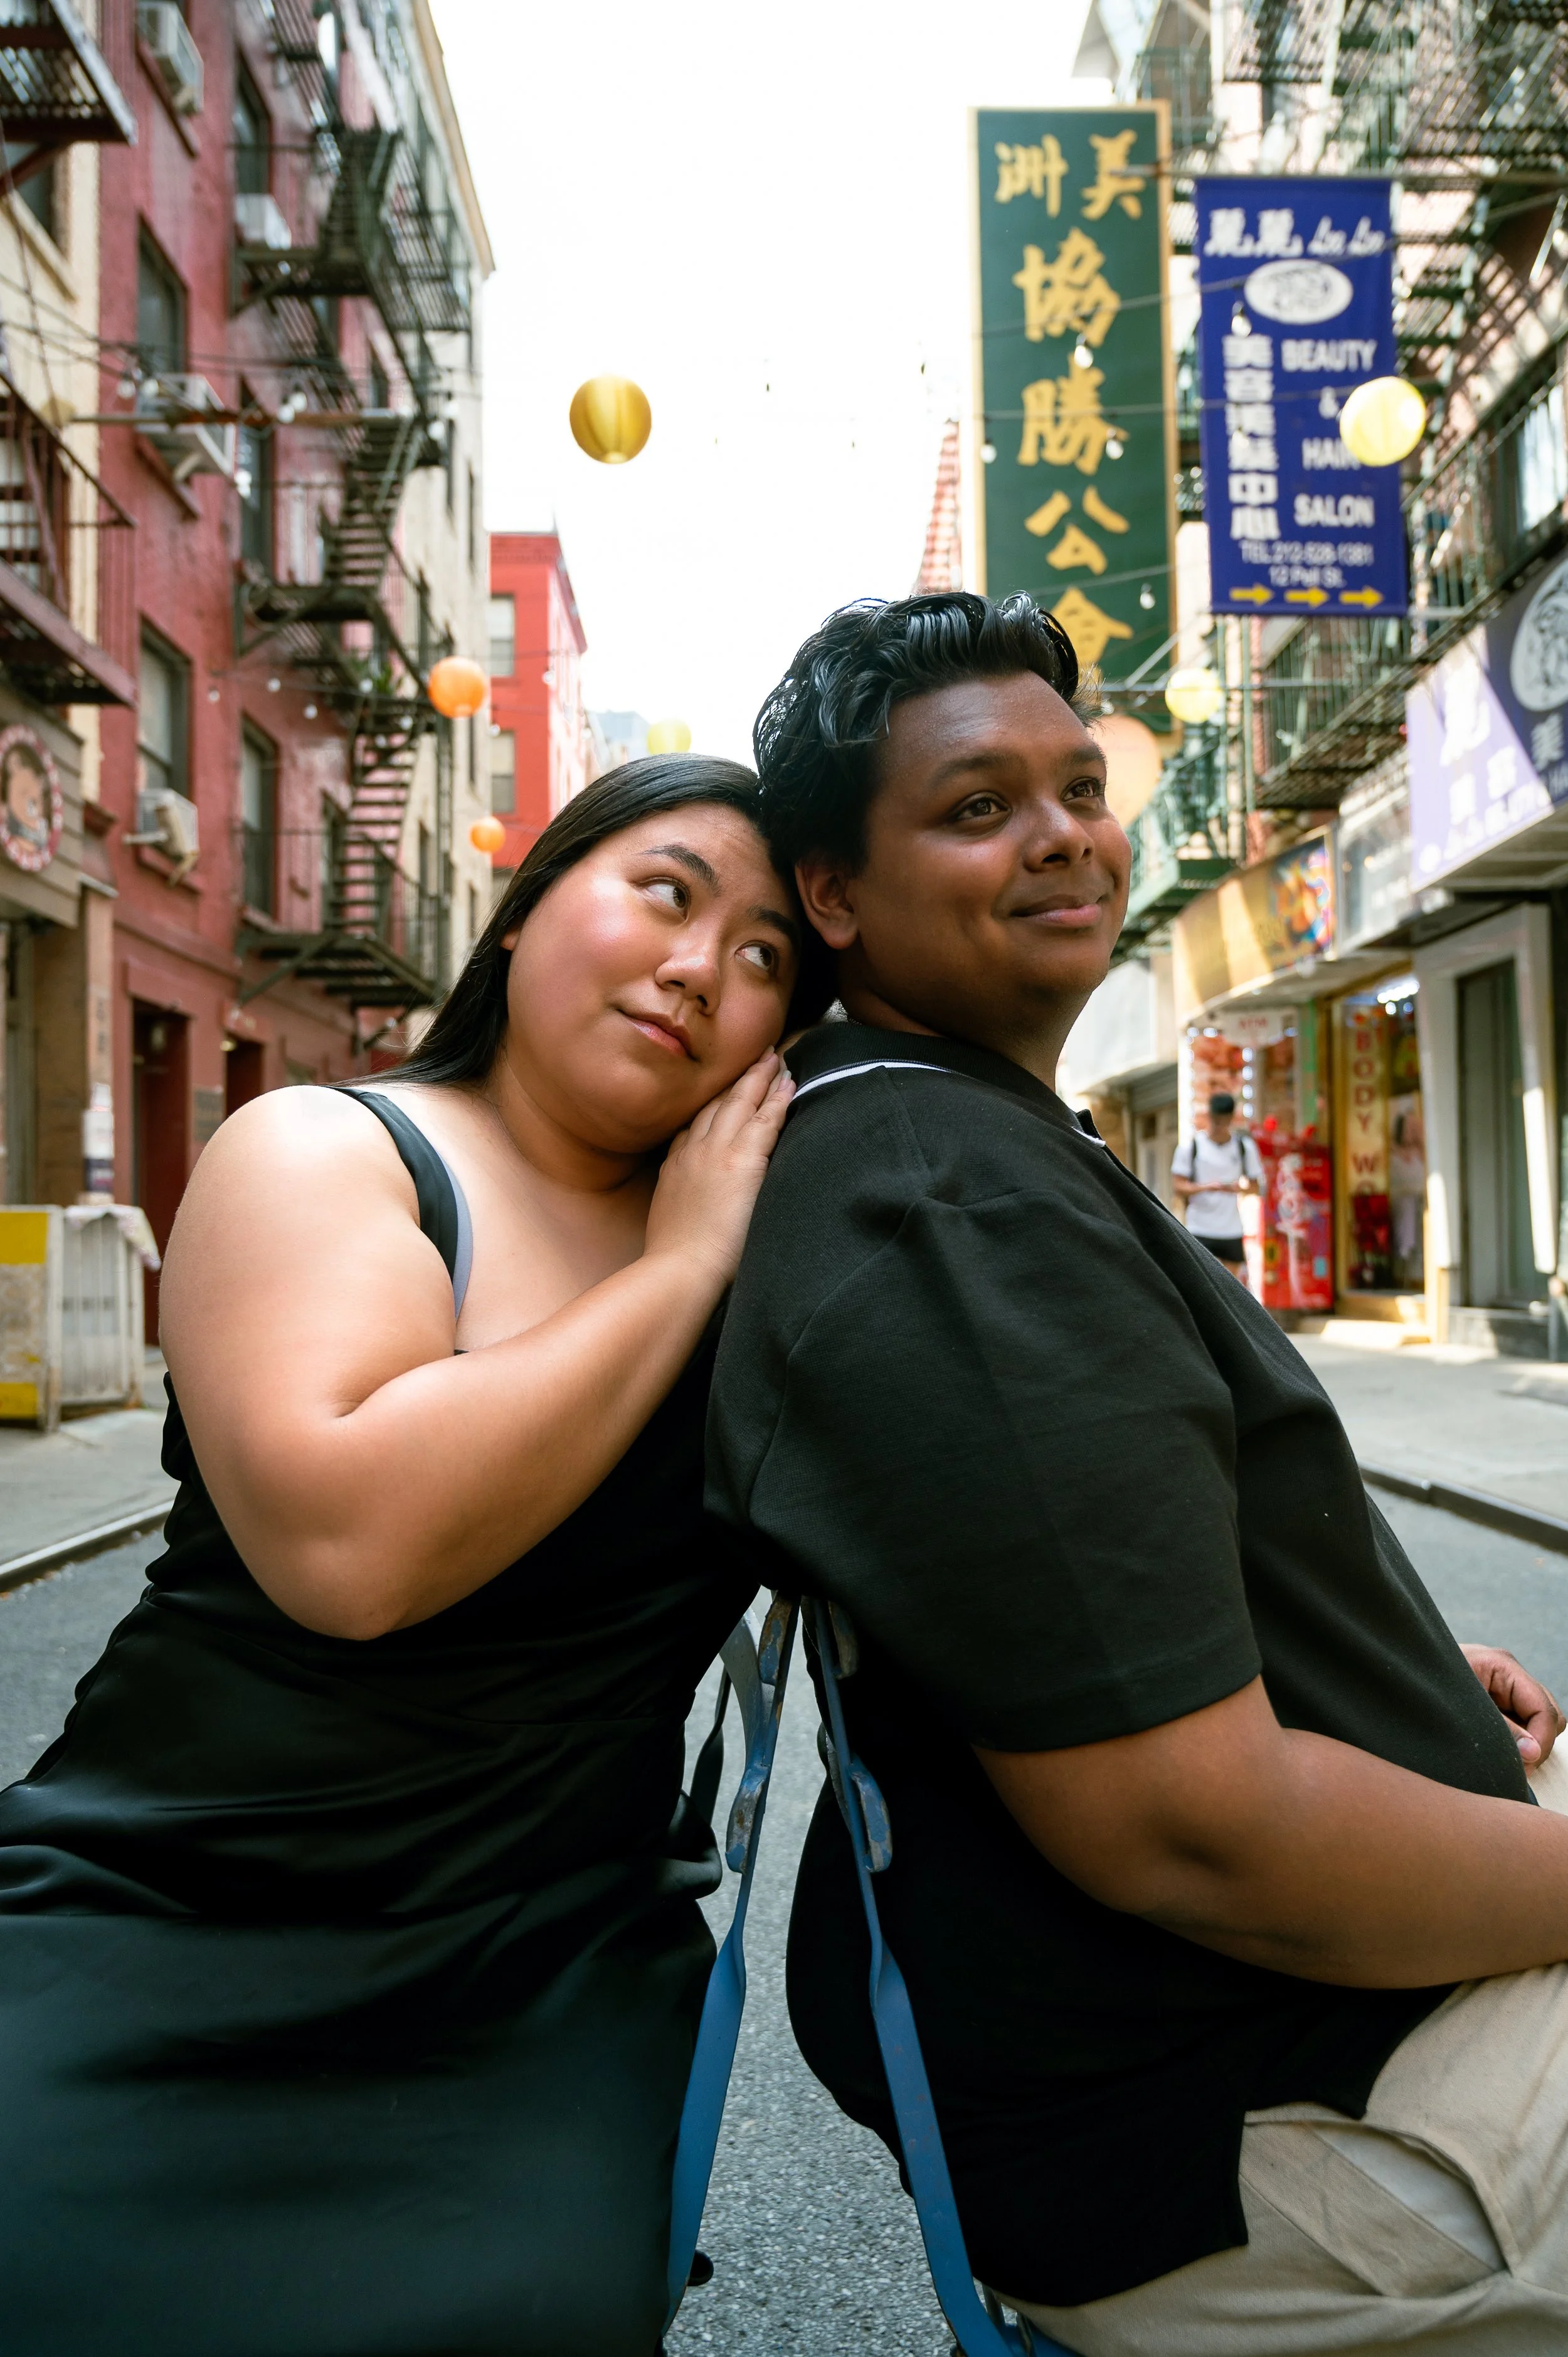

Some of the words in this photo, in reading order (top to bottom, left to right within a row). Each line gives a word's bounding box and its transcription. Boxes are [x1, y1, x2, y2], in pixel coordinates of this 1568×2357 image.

[1281, 339, 1378, 373] BEAUTY
[1318, 386, 1340, 419] &
[1293, 493, 1375, 528] SALON
